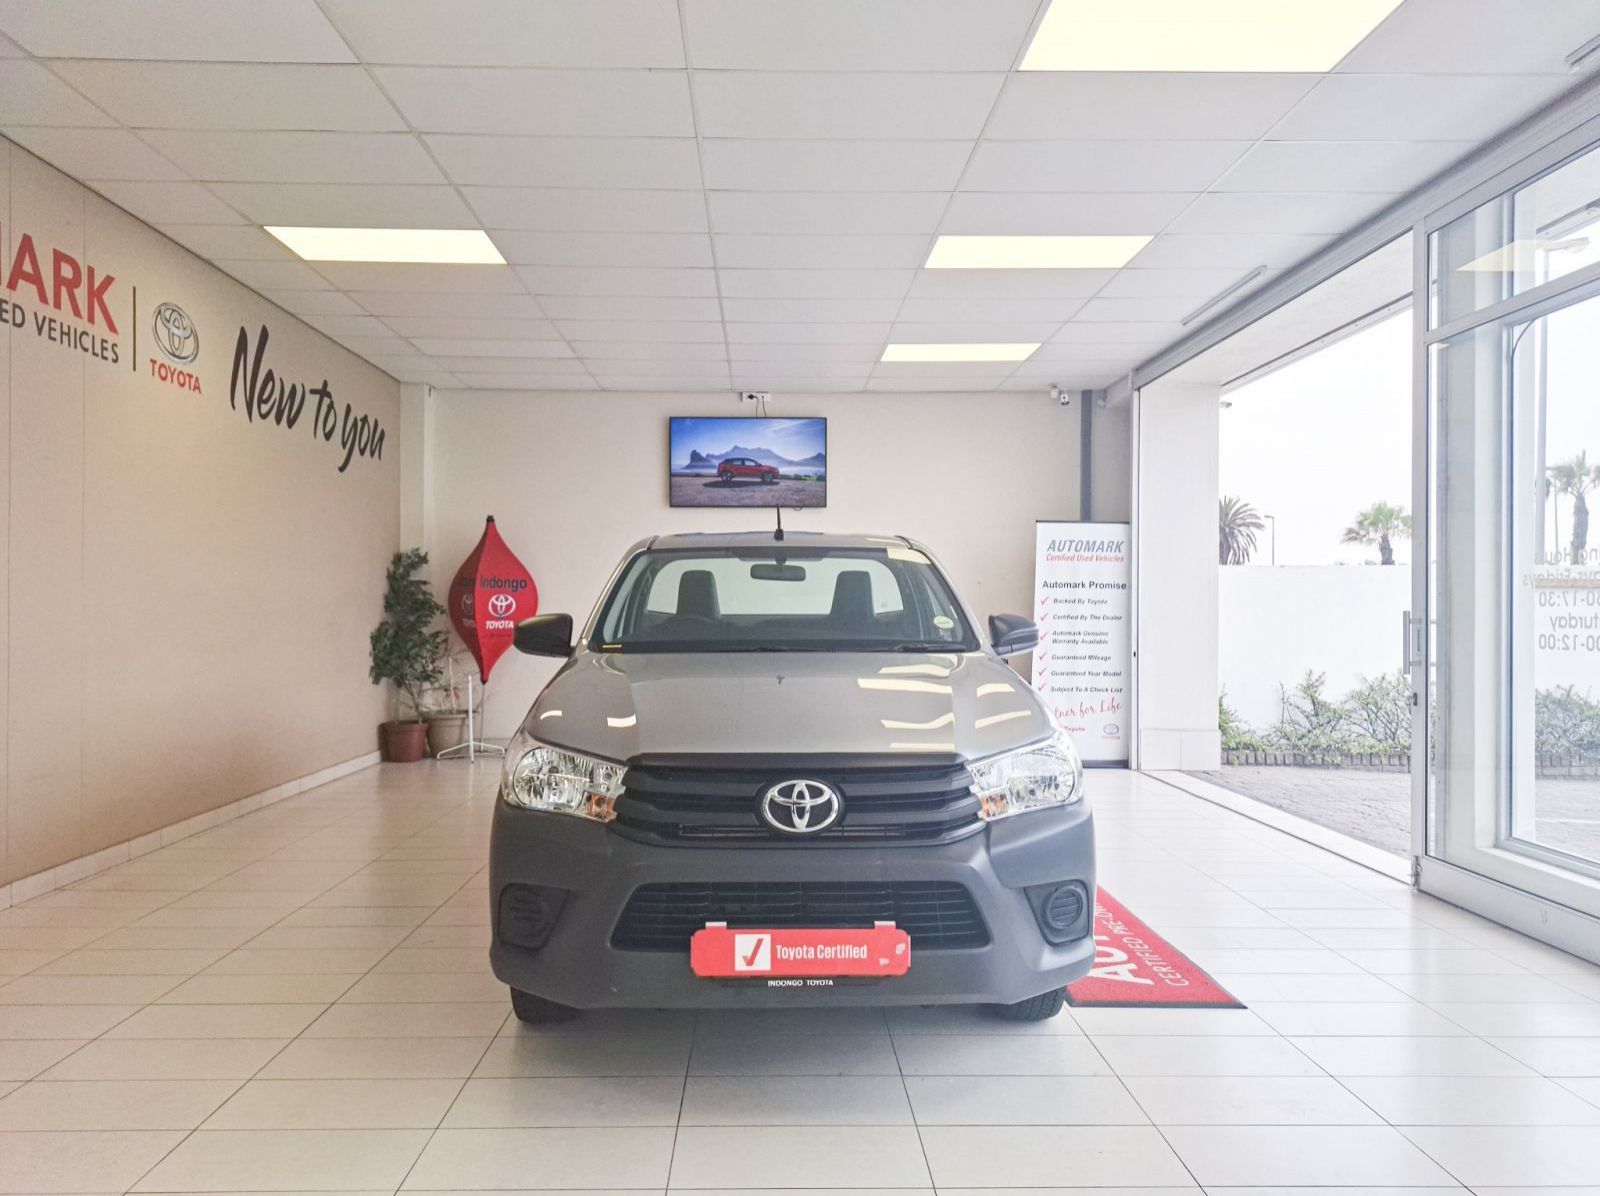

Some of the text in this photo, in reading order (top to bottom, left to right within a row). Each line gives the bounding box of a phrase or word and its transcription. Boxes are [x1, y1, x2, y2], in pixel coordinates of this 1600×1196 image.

[0, 223, 119, 335] ARK
[34, 311, 119, 364] VEHICLES
[150, 358, 201, 394] TOYOTA
[230, 324, 385, 473] New to you
[1046, 539, 1125, 553] AUTOMARK
[1046, 554, 1075, 562] Certified
[1095, 555, 1124, 563] Vehicles
[480, 576, 527, 592] Indongo
[1042, 581, 1127, 590] Automark Promise
[1077, 598, 1086, 606] By
[1088, 598, 1108, 606] Toyota
[485, 620, 514, 630] TOYOTA
[1087, 654, 1112, 662] Mileage
[776, 944, 868, 961] Toyota Certified
[1122, 937, 1189, 986] CERTIFIED
[767, 979, 834, 987] INDONGO TOYOTA
